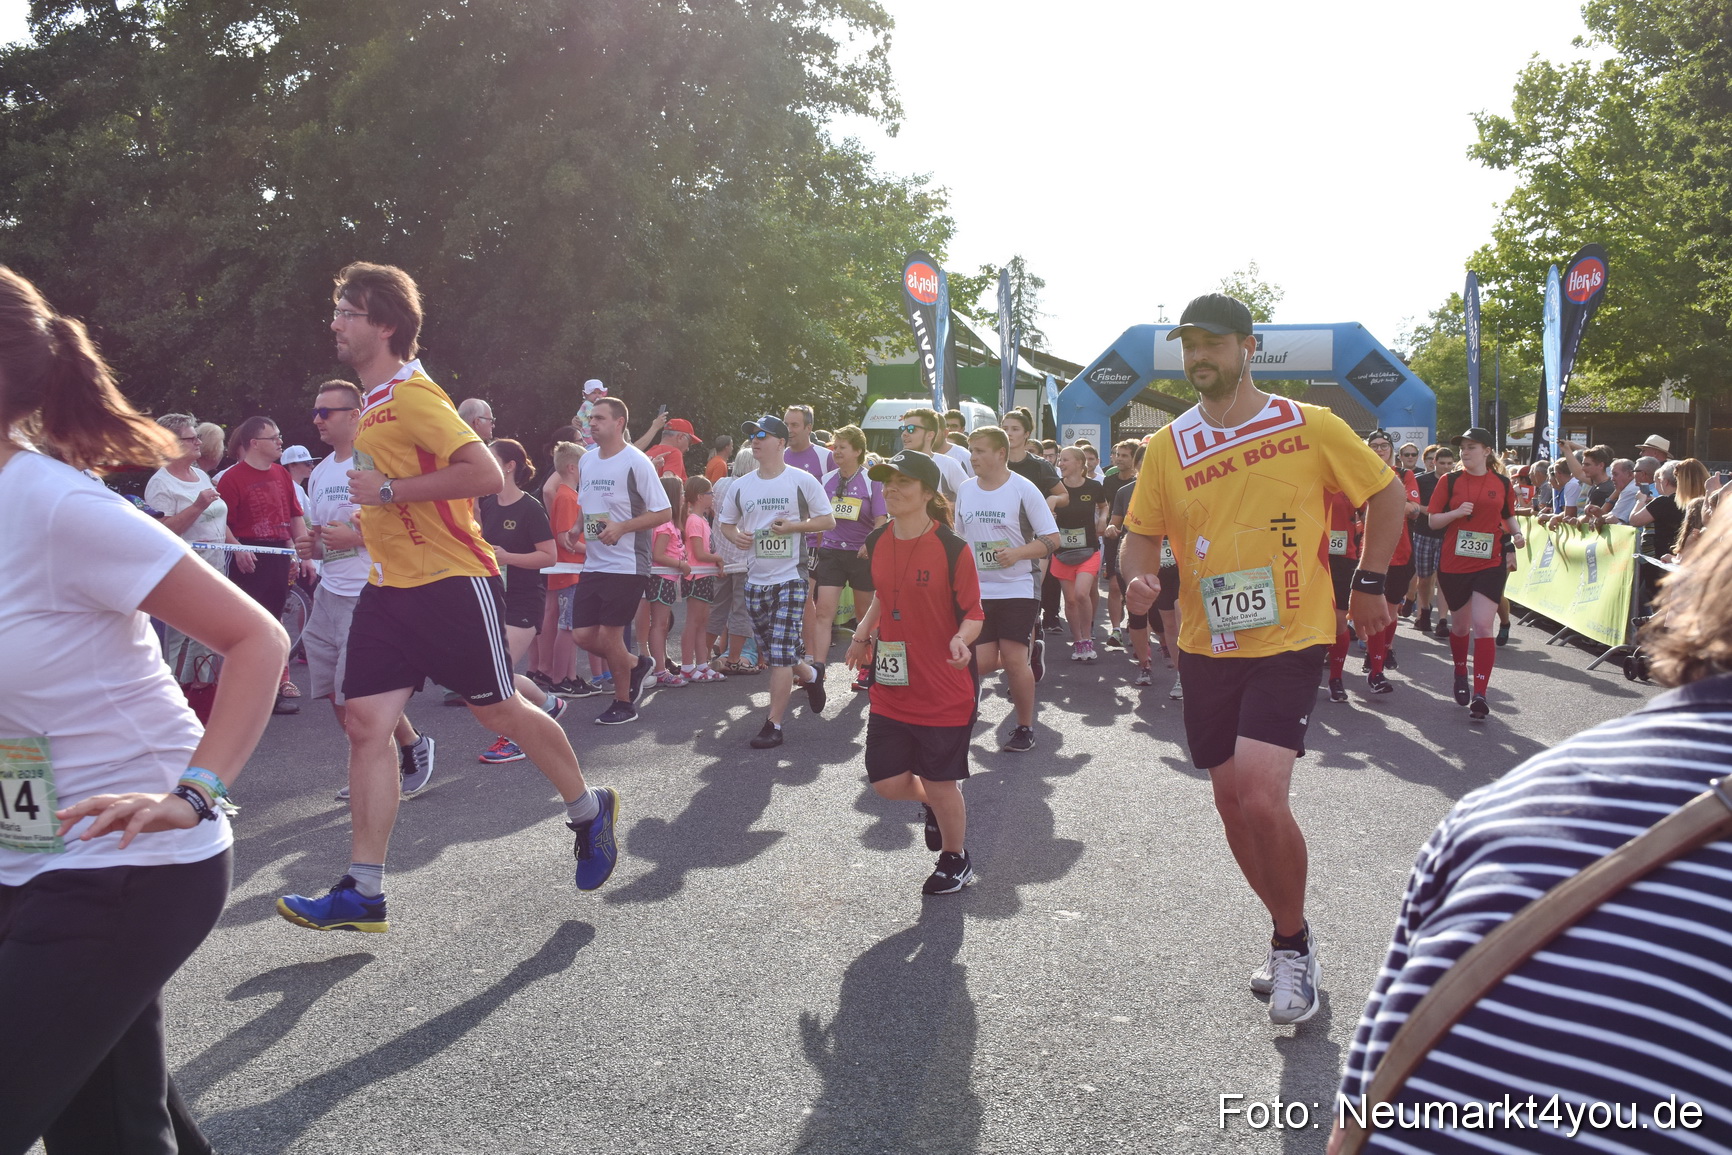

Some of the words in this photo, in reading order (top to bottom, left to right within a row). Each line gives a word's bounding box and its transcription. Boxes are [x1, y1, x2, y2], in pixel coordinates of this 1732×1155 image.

[1568, 268, 1602, 292] Hervis
[1097, 372, 1132, 381] Fischer
[1184, 457, 1237, 491] MAX
[1243, 435, 1310, 467] BÖGL
[324, 485, 349, 495] HAUBNE
[327, 494, 349, 502] TREPPEN
[756, 497, 790, 505] HAUBNER
[835, 504, 853, 514] 888
[1066, 535, 1078, 543] 65
[210, 544, 277, 554] Raiffeisenbank
[759, 539, 787, 551] 1001
[1460, 539, 1488, 552] 2330
[979, 551, 998, 563] 100
[916, 569, 930, 582] 13
[1211, 589, 1266, 617] 1705
[1221, 615, 1240, 623] Ziegler
[1240, 611, 1258, 620] David
[470, 691, 494, 700] adidas
[17, 769, 44, 779] 2019
